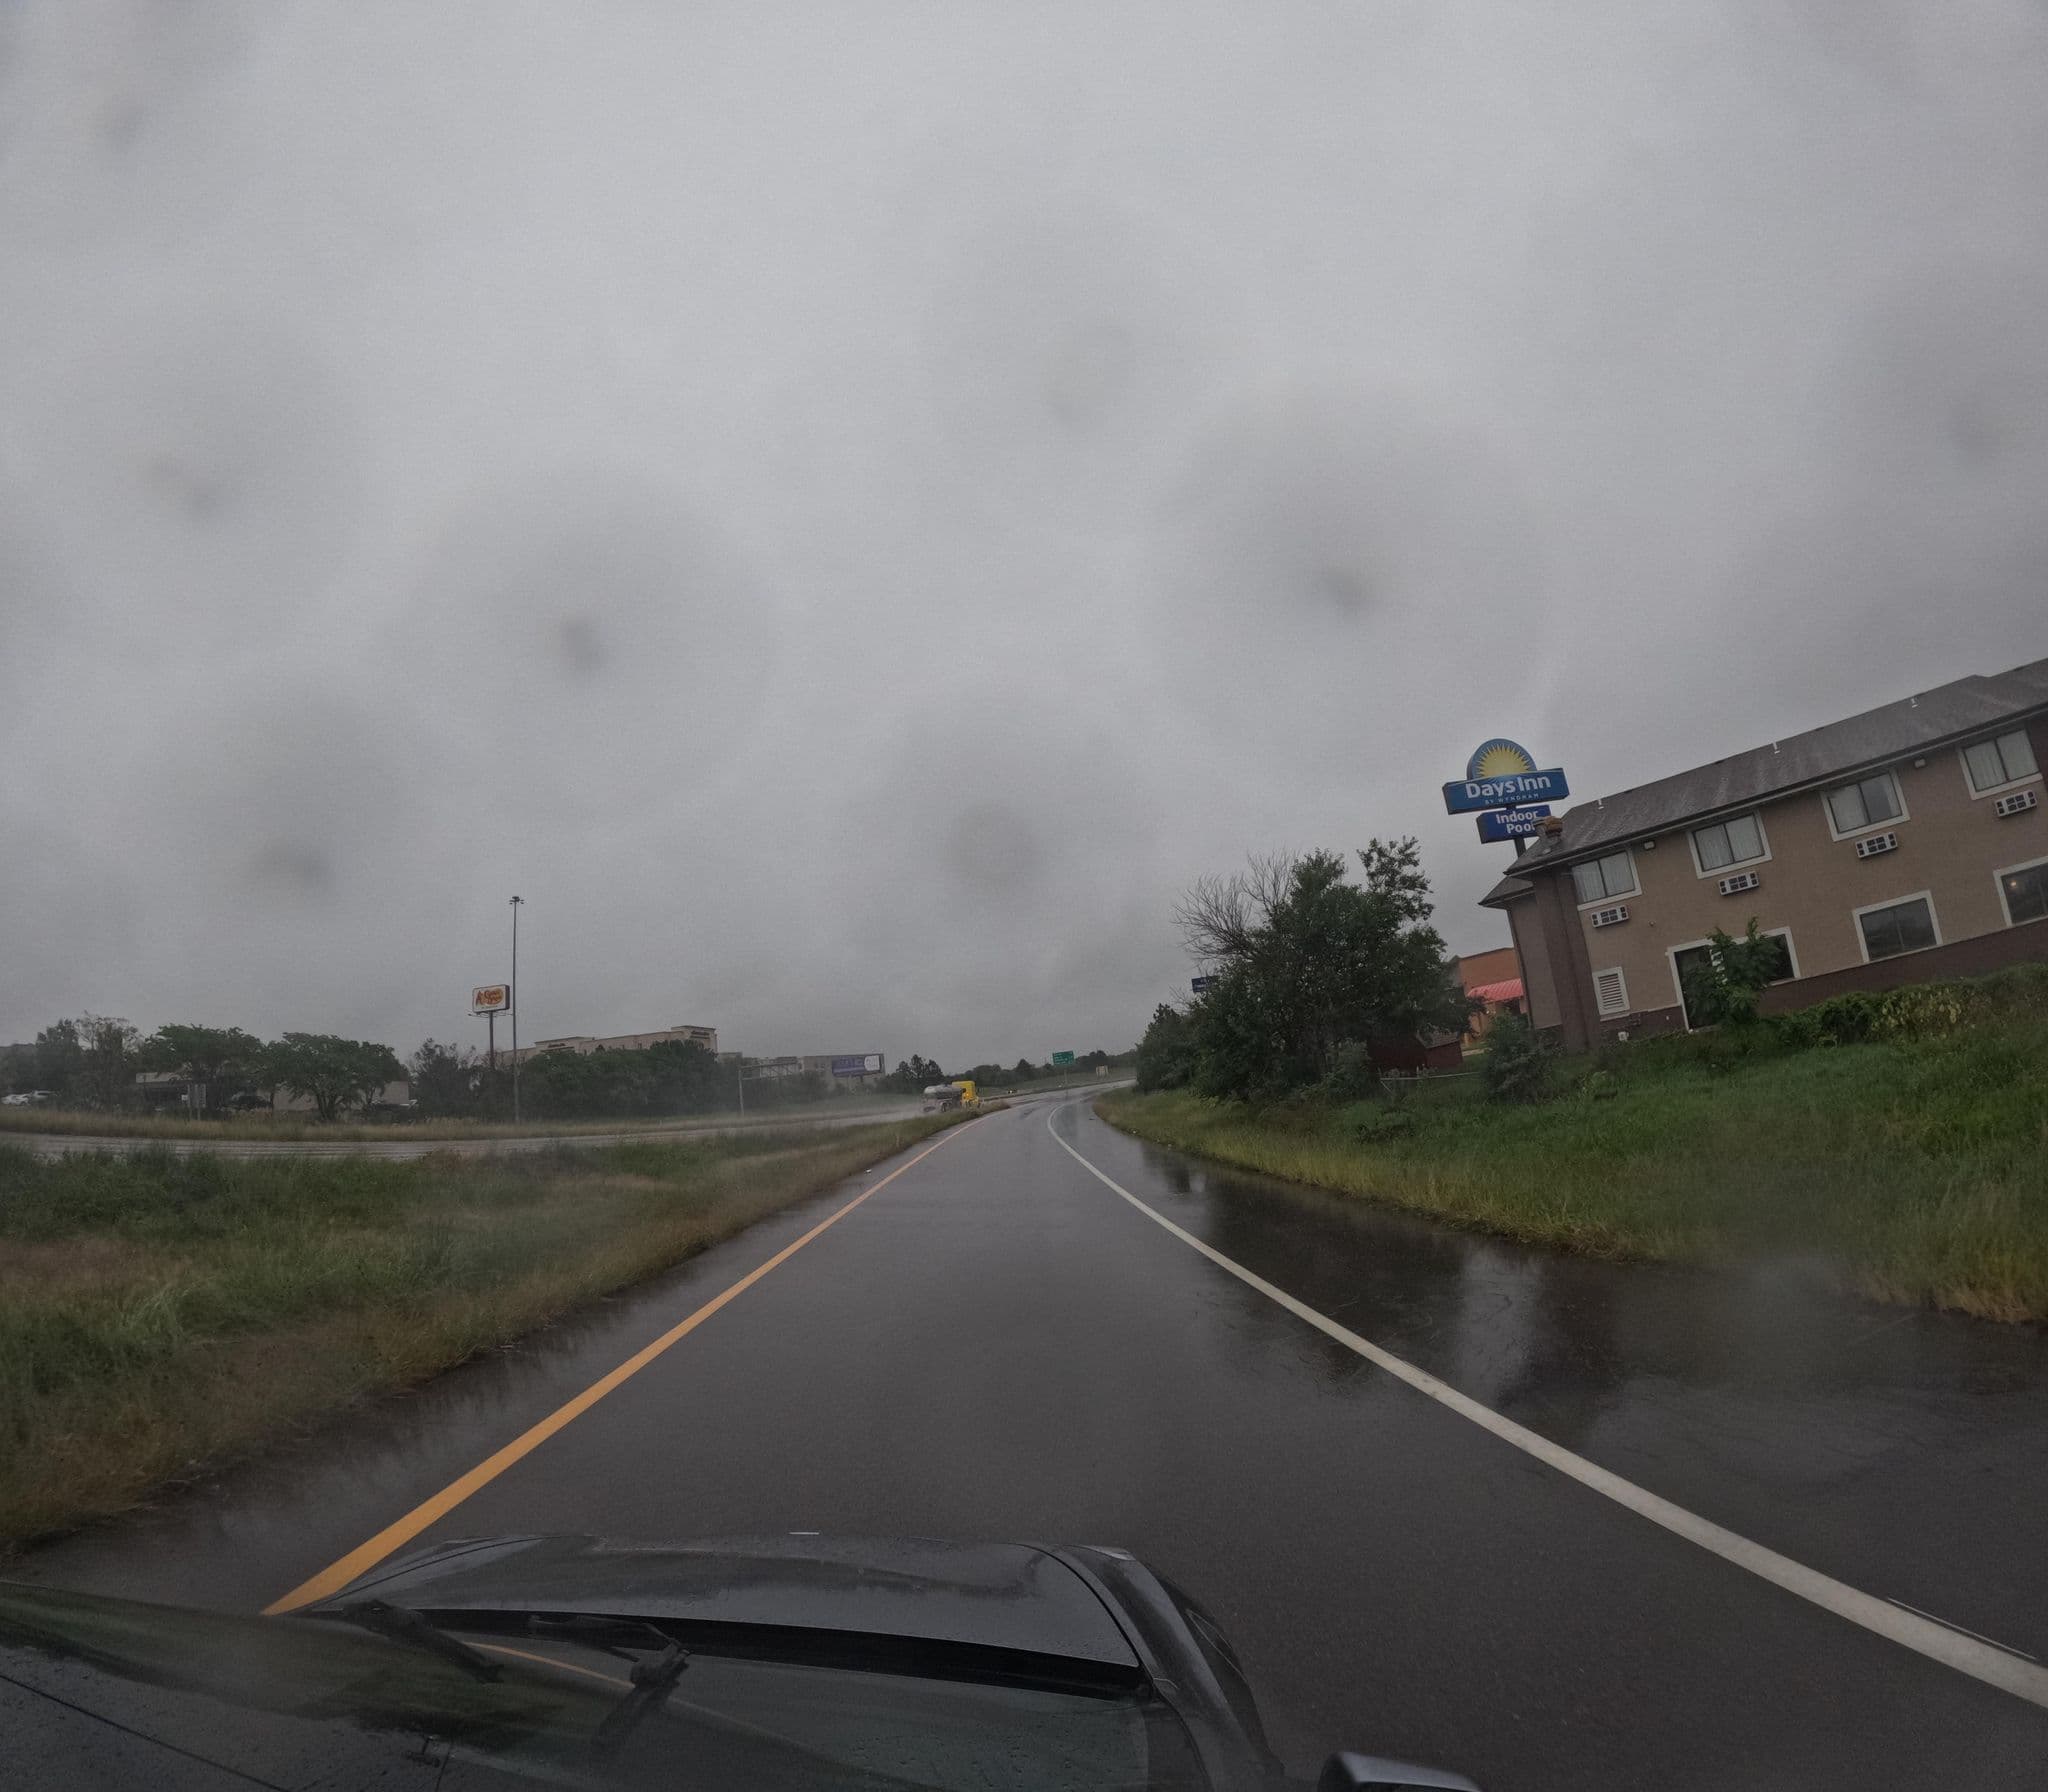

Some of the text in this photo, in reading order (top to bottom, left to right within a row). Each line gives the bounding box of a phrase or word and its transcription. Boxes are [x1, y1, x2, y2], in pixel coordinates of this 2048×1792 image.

[1465, 776, 1552, 799] Days Inn
[1495, 810, 1538, 824] Indoor
